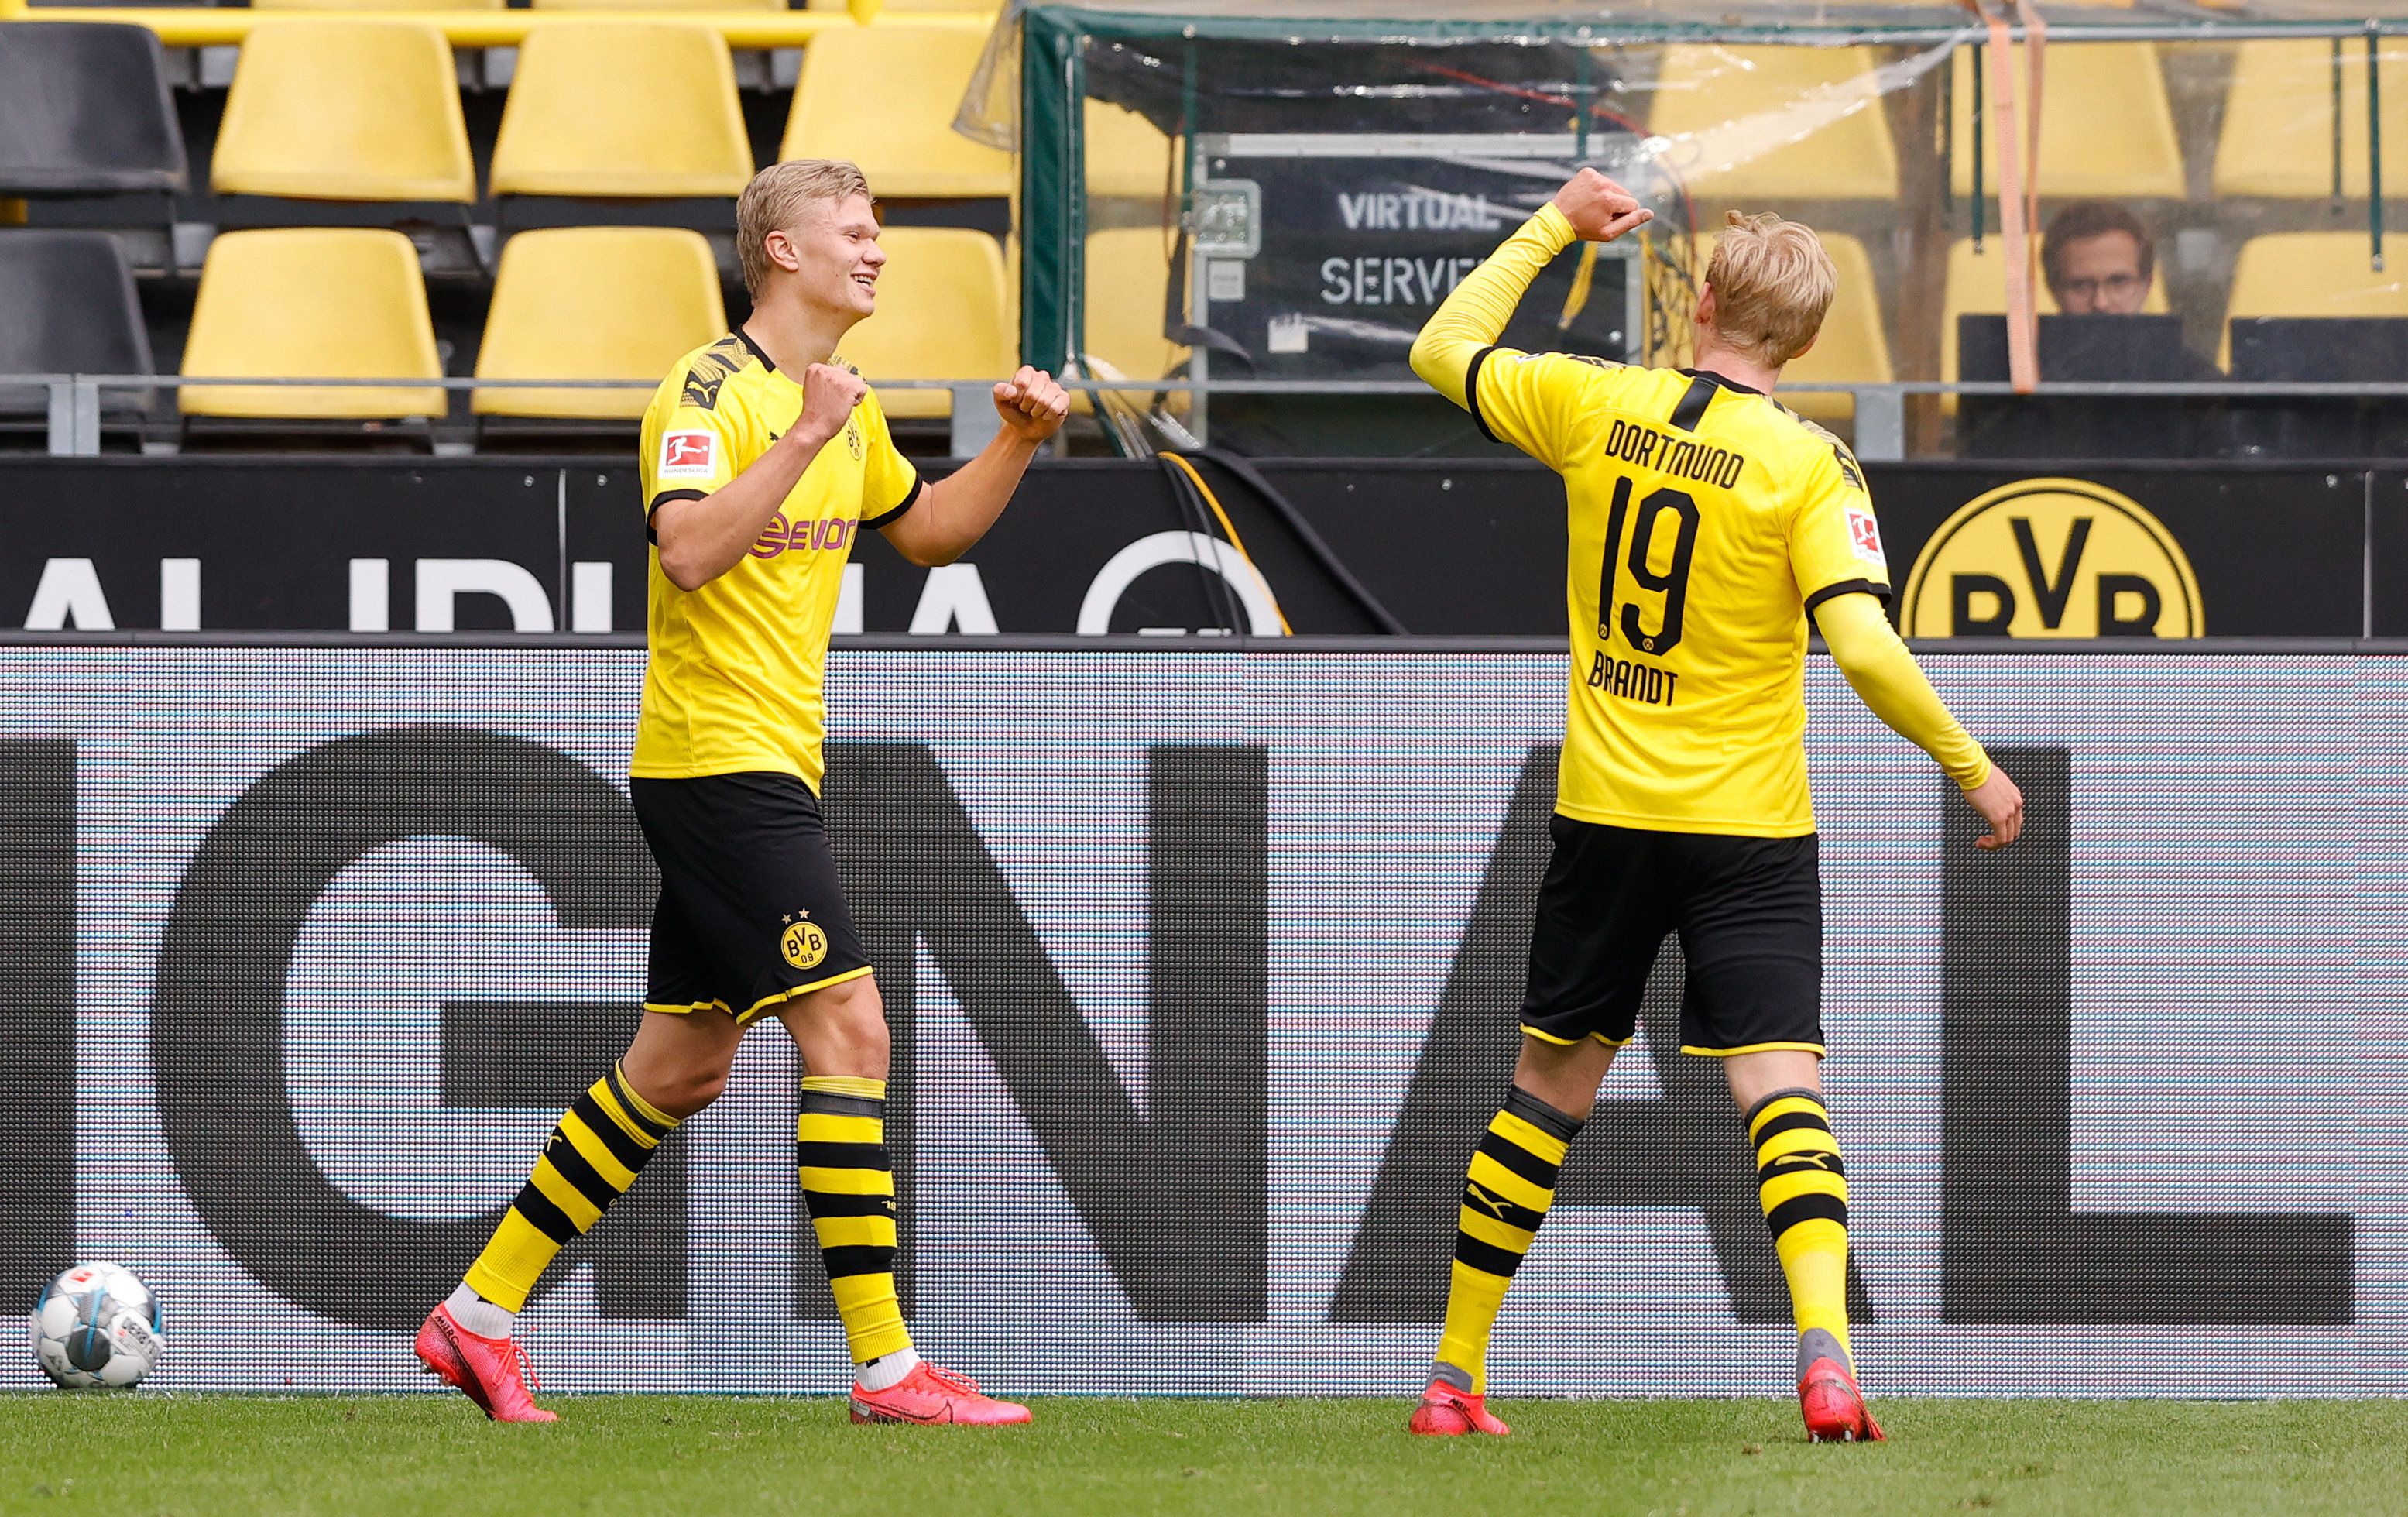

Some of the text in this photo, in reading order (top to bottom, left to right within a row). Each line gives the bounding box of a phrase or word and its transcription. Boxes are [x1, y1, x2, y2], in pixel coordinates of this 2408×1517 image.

[1338, 192, 1501, 230] VIRTUAL
[1321, 257, 1486, 305] SERVE
[1605, 420, 1744, 489] DORTMUND
[1598, 475, 1700, 656] 19
[1588, 650, 1678, 706] BRANDT
[787, 927, 822, 957] BVB
[801, 953, 814, 963] 09
